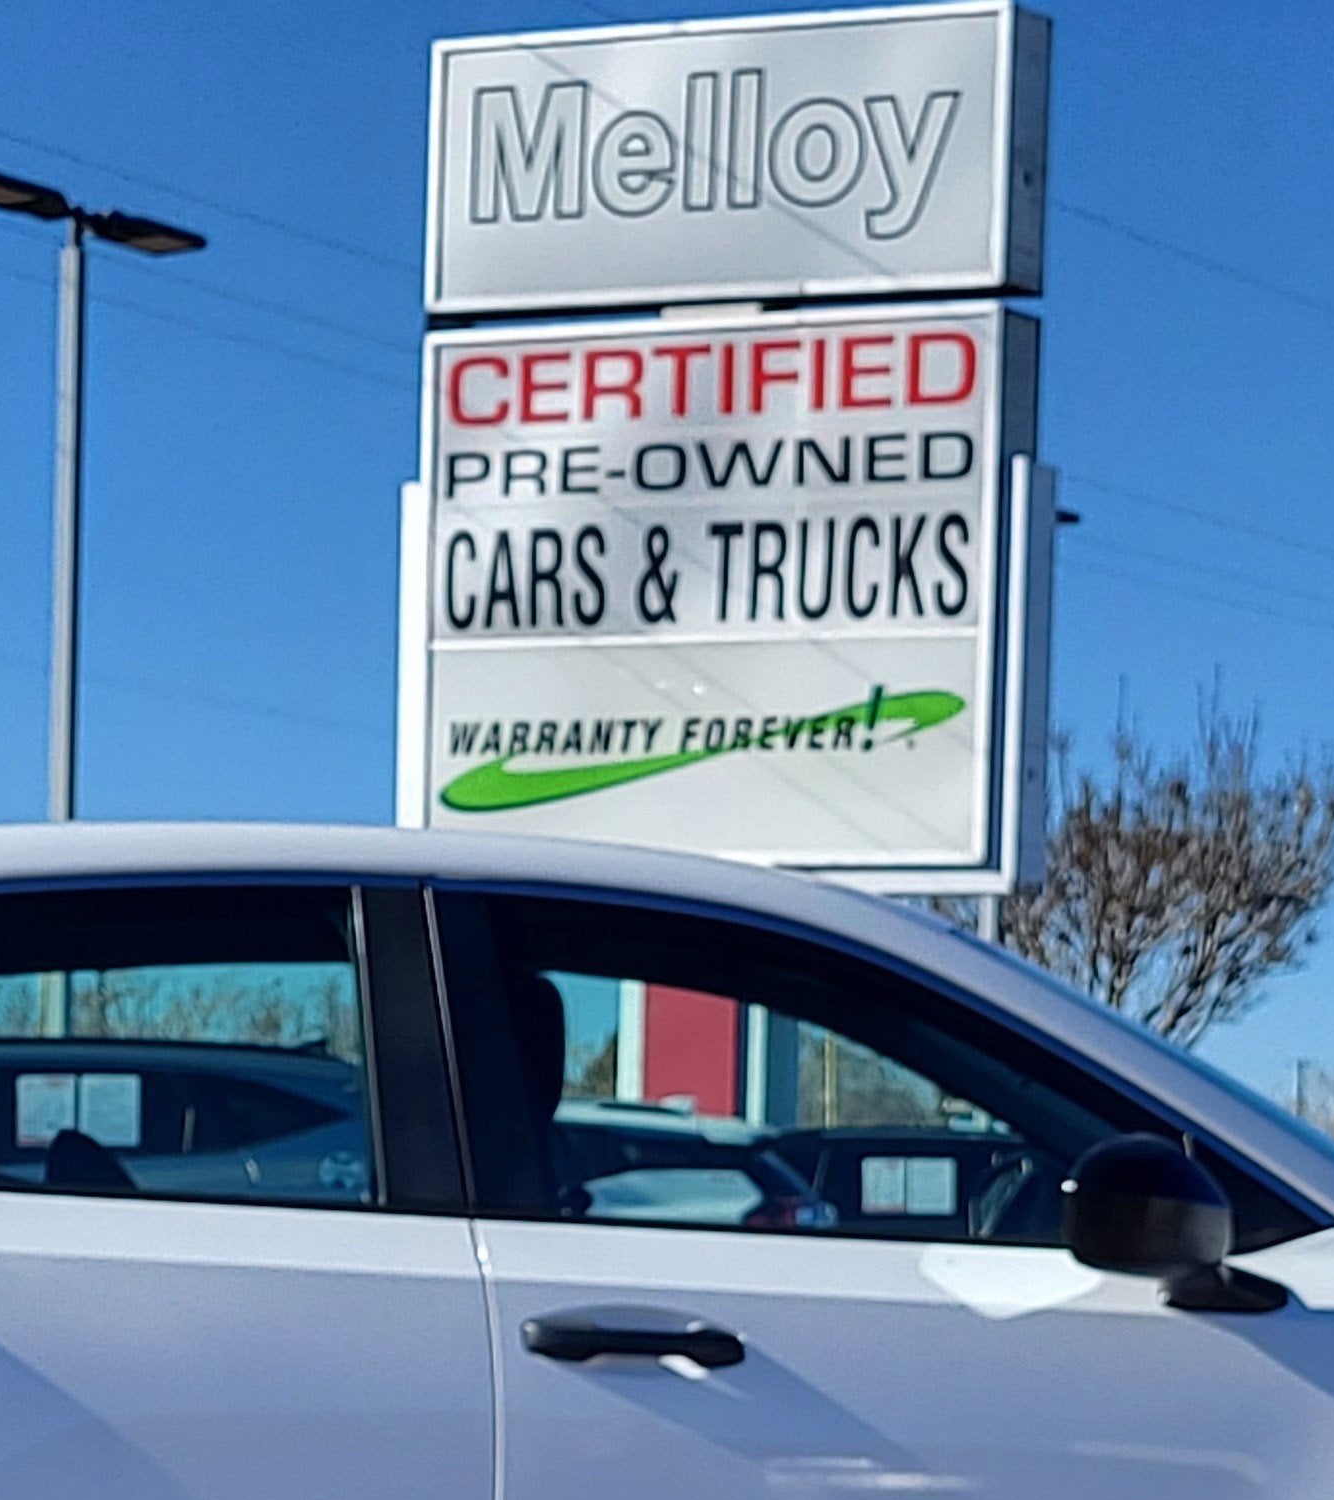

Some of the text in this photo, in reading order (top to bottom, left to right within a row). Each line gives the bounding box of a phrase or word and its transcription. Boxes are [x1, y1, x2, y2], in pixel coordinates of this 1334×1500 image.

[470, 69, 962, 240] Melloy
[448, 331, 978, 428] CERTIFIED
[448, 429, 973, 498] PRE-OWNED
[446, 513, 970, 630] CARS & TRUCKS
[449, 717, 664, 756] WARRANTY
